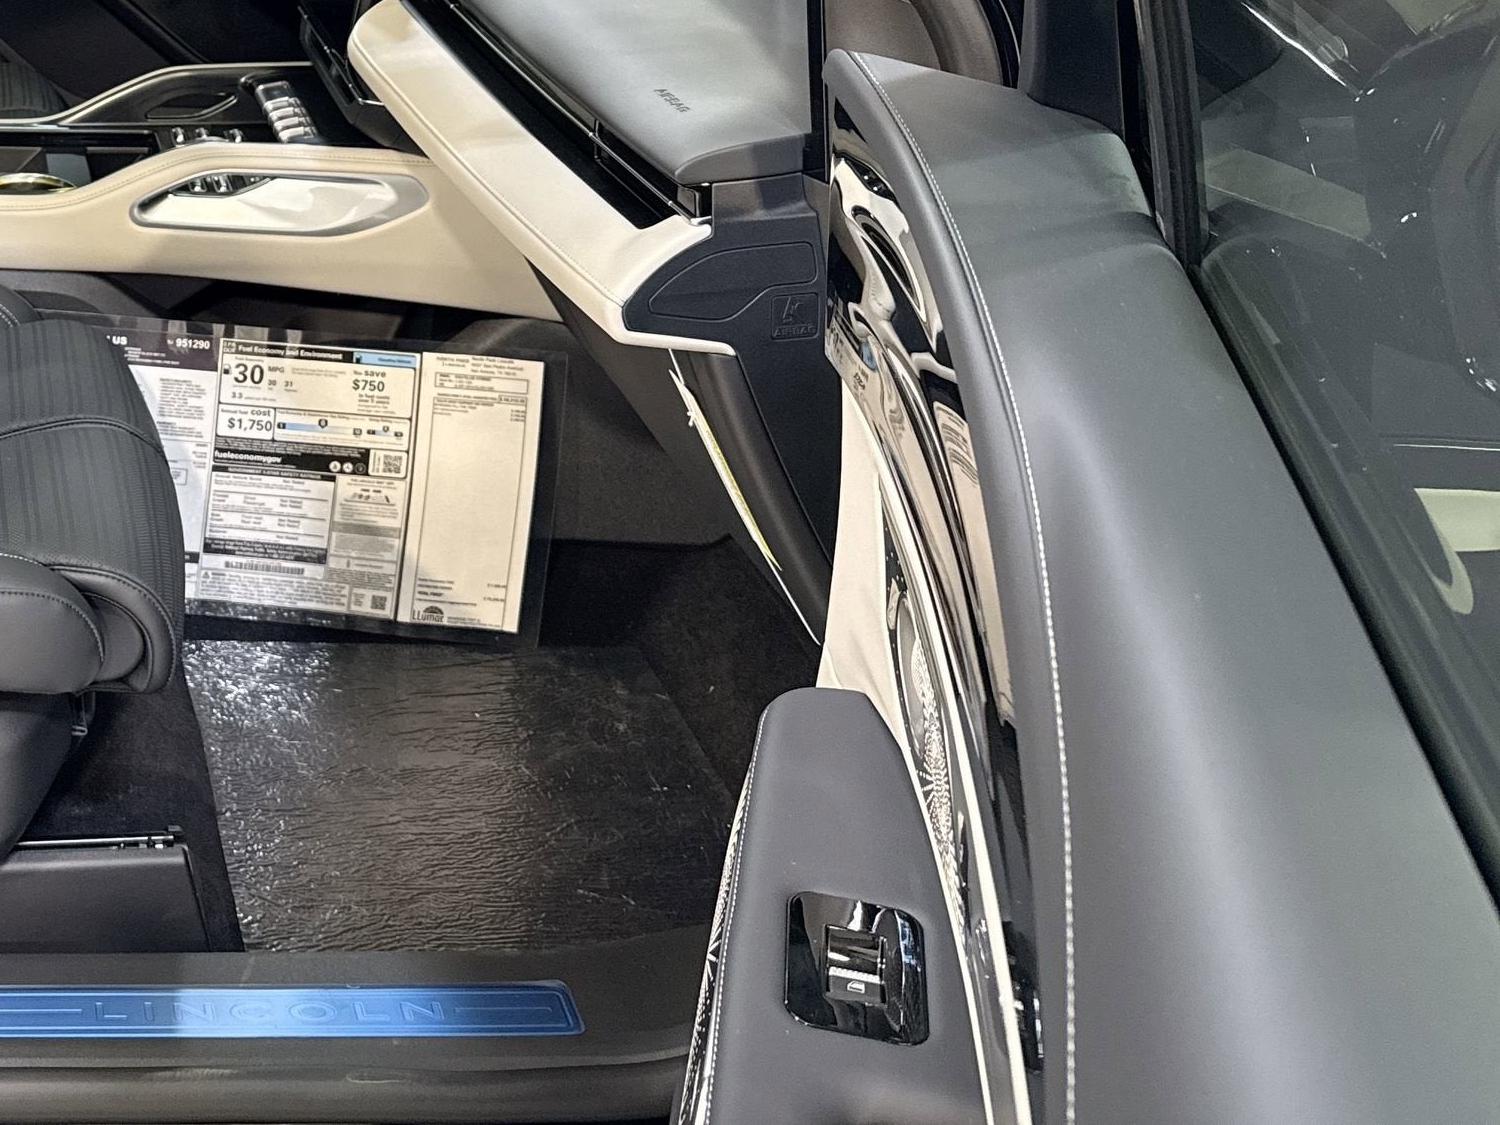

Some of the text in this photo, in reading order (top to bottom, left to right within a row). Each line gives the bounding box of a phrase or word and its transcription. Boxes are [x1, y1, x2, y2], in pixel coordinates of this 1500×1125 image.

[653, 89, 691, 113] AIRBAG
[773, 326, 817, 338] AIRBAG
[175, 338, 211, 350] 951290
[238, 344, 253, 353] Fuel
[254, 345, 285, 356] Economy
[300, 349, 343, 360] Environment
[234, 362, 265, 385] 30
[268, 365, 285, 374] MPG
[364, 370, 387, 378] save
[352, 379, 385, 392] $750
[227, 418, 273, 432] $1,750
[412, 609, 444, 623] LLumar
[93, 1000, 446, 1024] LINCOLN
